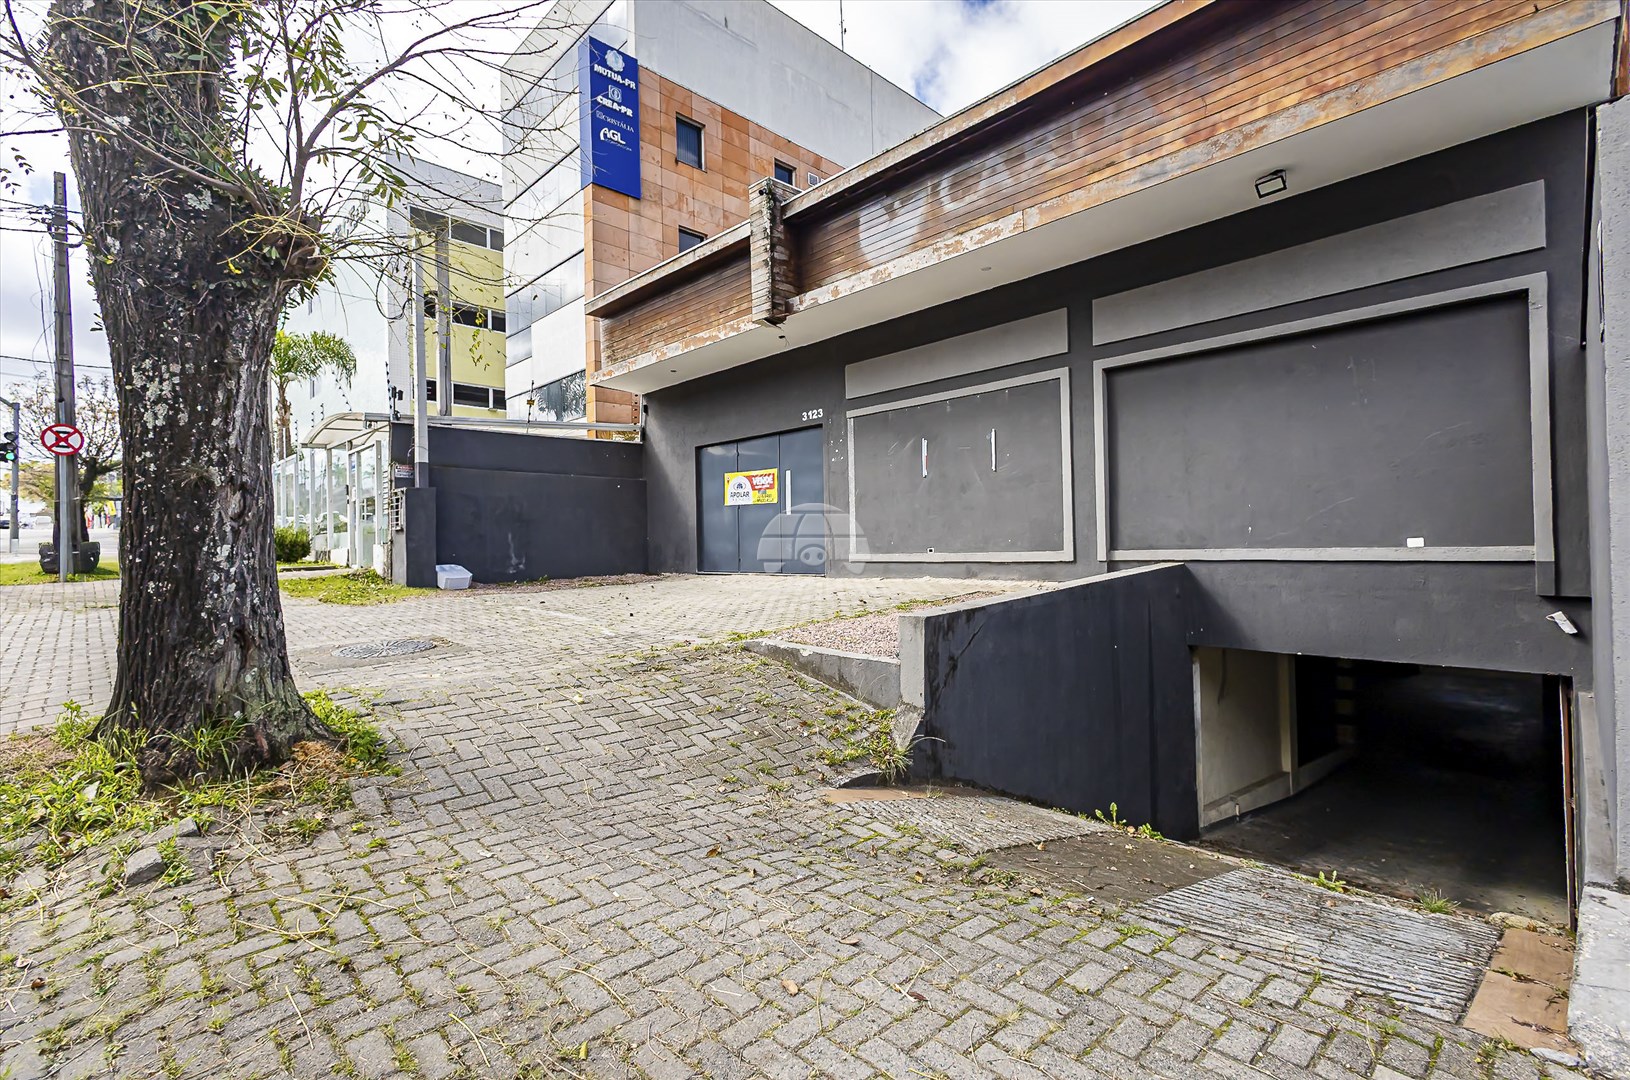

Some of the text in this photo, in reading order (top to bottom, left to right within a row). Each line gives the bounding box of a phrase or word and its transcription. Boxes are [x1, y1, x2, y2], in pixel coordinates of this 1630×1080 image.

[596, 95, 633, 117] CREA-PR
[600, 127, 626, 145] AGL
[801, 408, 823, 421] 3123
